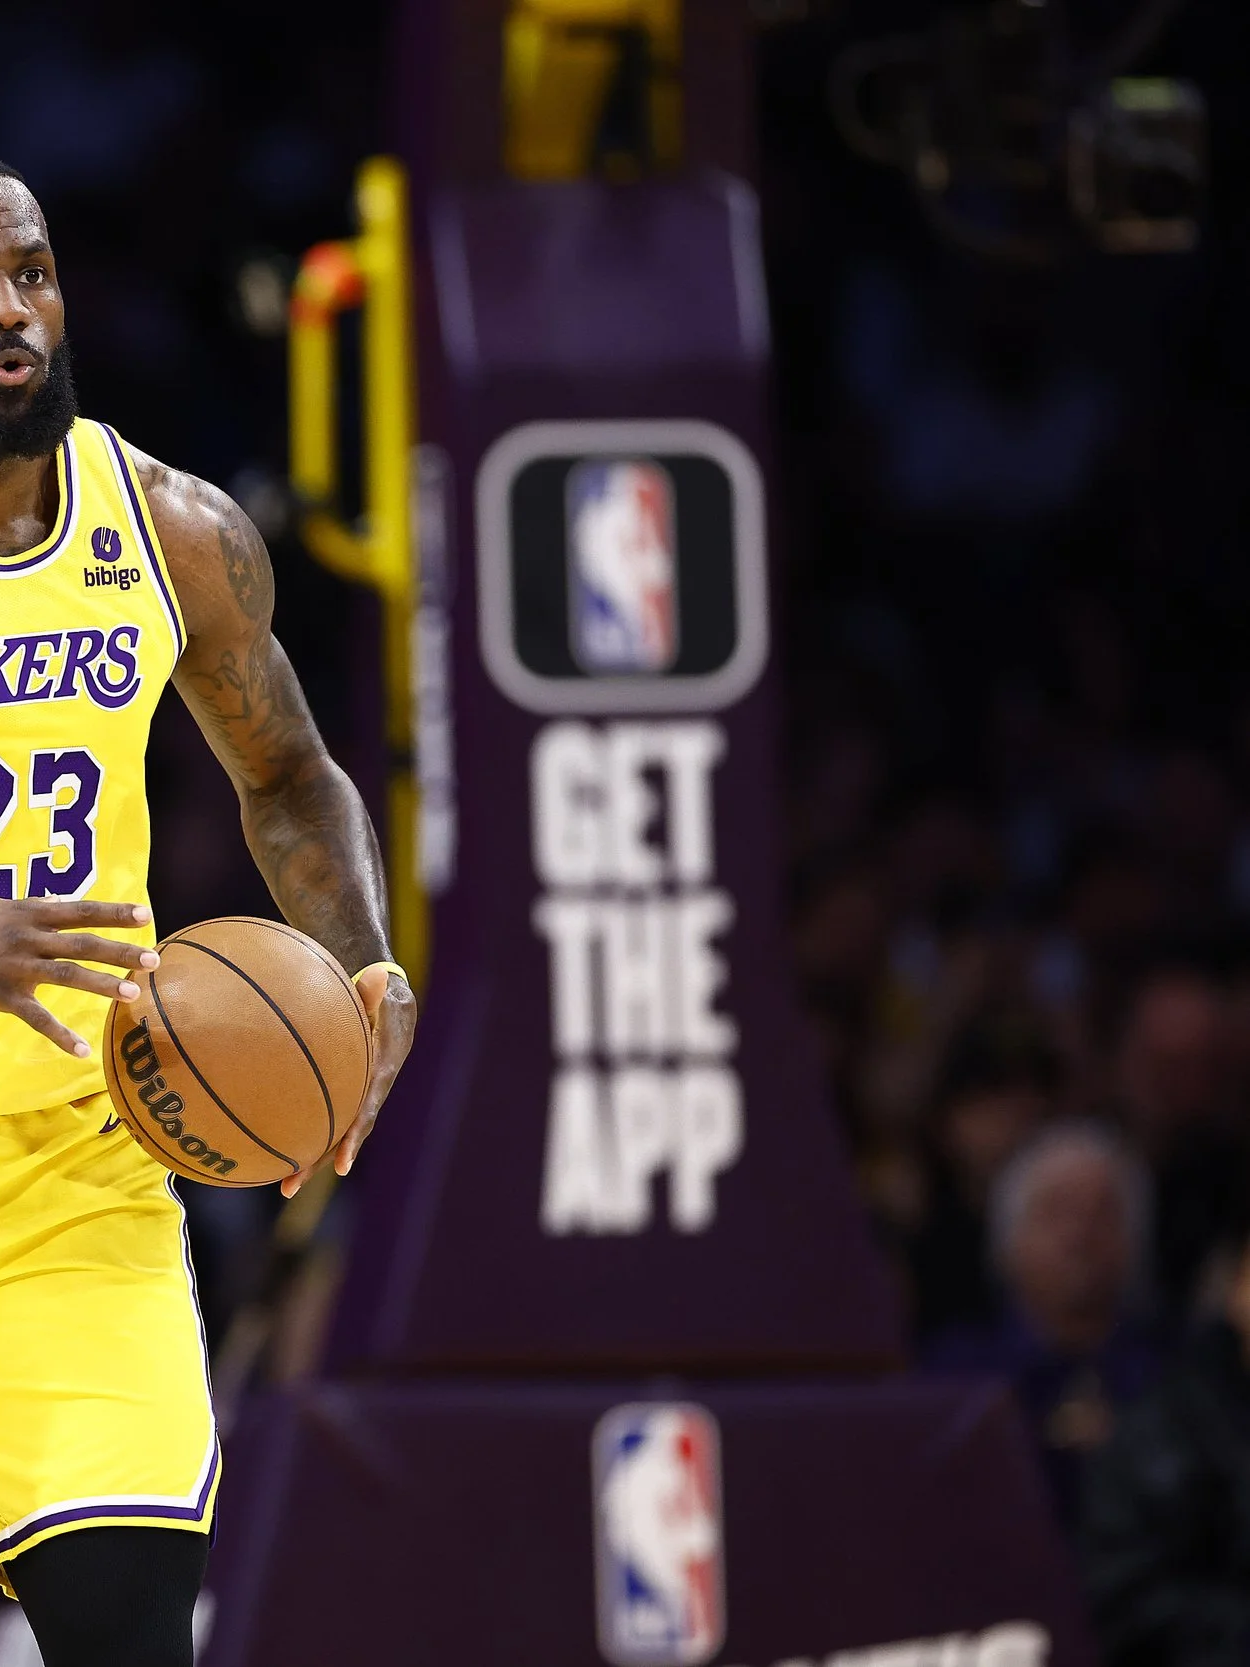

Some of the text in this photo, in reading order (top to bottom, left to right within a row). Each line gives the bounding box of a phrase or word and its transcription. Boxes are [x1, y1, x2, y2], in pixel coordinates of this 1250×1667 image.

[83, 565, 141, 591] bibigo
[531, 719, 727, 887] GET
[530, 890, 738, 1058] THE
[120, 1016, 239, 1176] Wilson
[541, 1063, 746, 1234] APP
